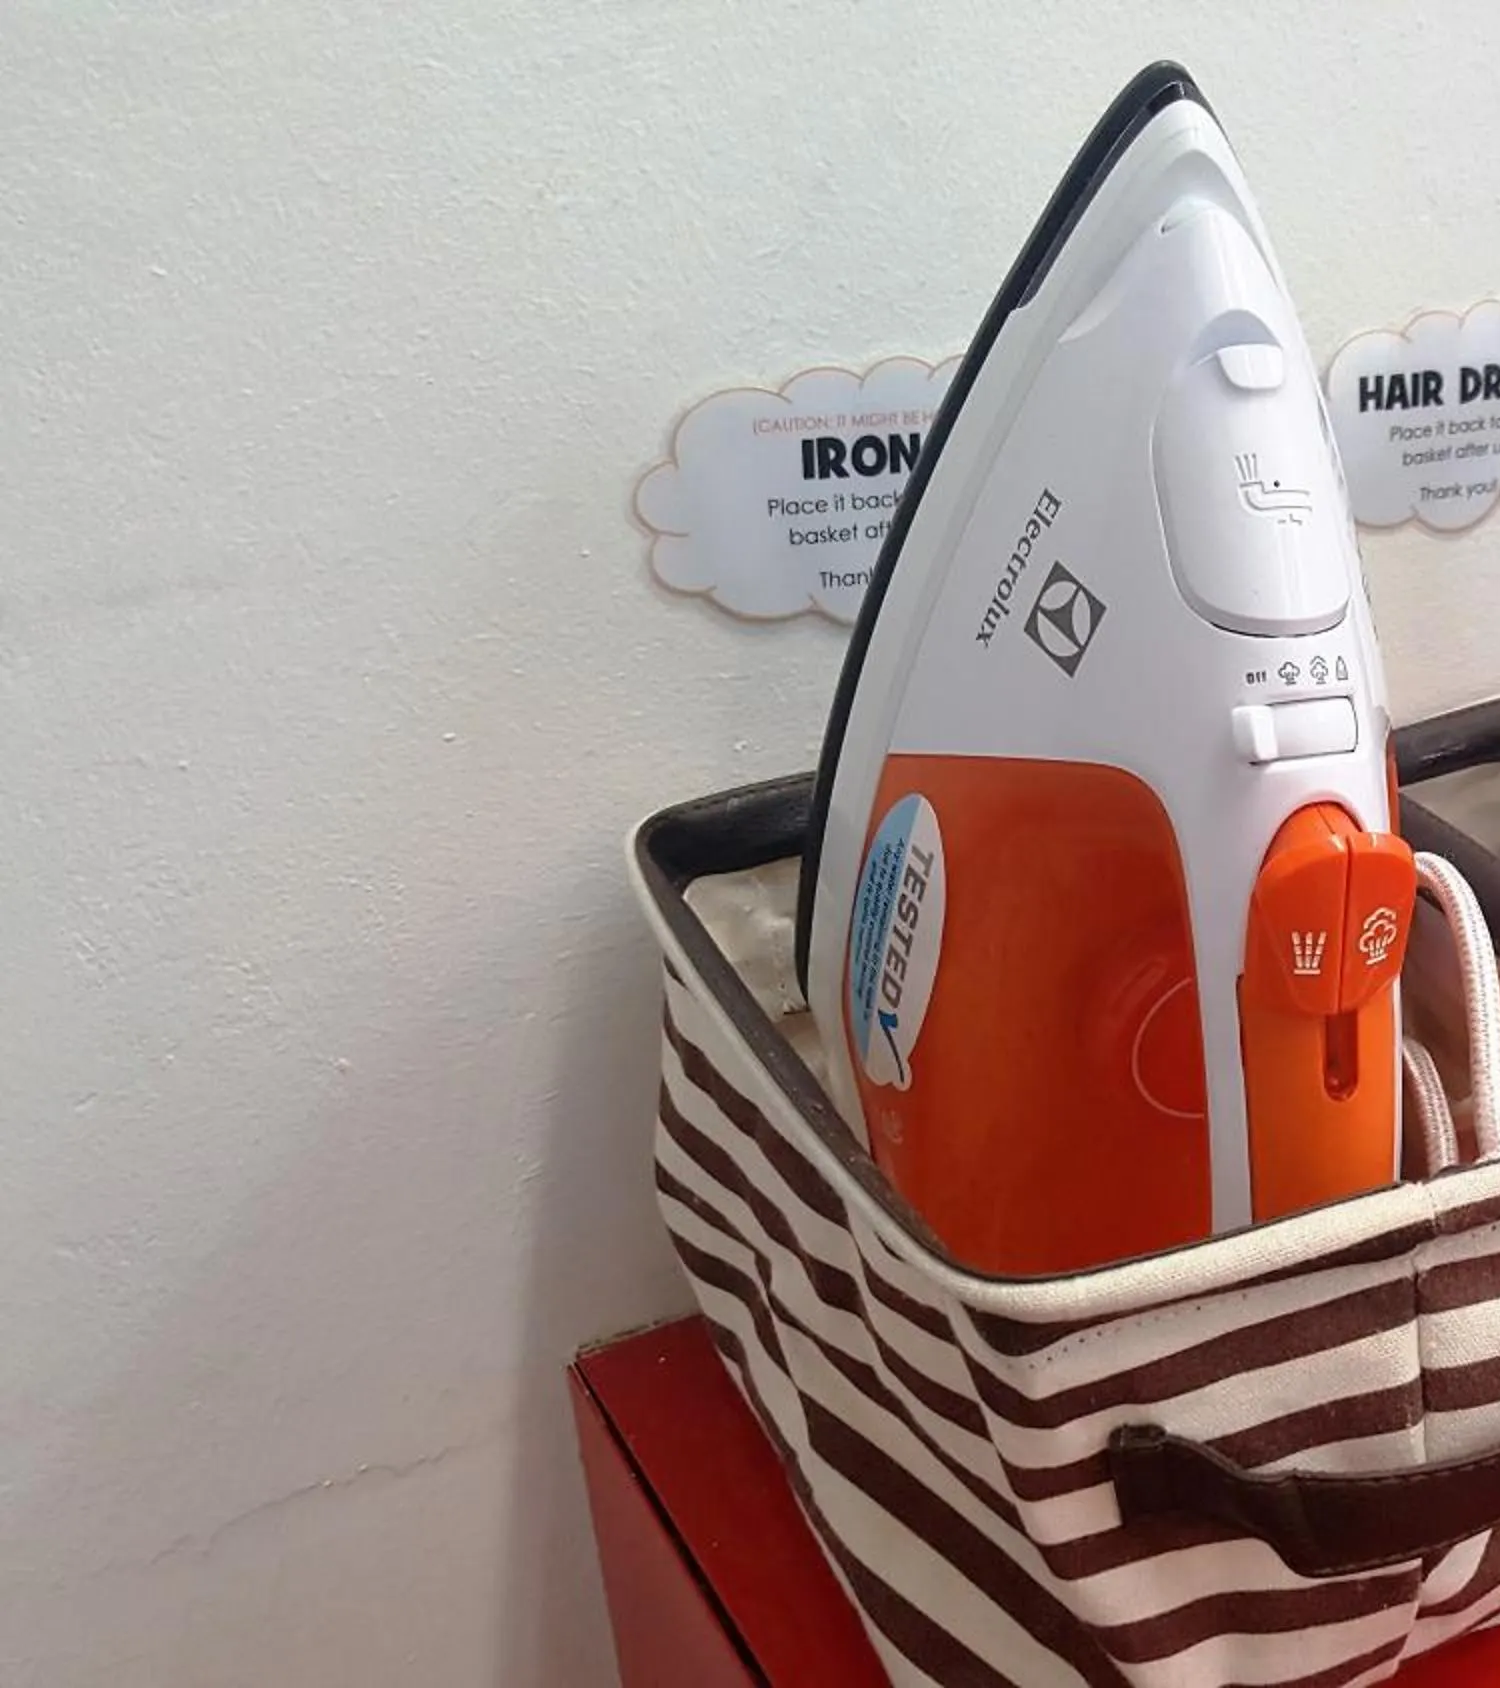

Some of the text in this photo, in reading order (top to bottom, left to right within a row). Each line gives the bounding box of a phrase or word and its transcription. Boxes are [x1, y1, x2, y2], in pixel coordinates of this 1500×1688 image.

[1358, 370, 1445, 413] HAIR
[851, 411, 899, 428] MIGHT
[903, 409, 921, 426] BE
[1389, 424, 1433, 442] Place
[1436, 420, 1446, 435] it
[1448, 417, 1486, 435] back
[800, 433, 921, 480] IRON
[1402, 446, 1453, 467] basket
[1455, 442, 1489, 459] after
[1419, 481, 1462, 501] Thank
[767, 494, 828, 518] Place
[834, 493, 847, 512] it
[789, 522, 858, 546] basket
[975, 487, 1062, 648] Electrolux
[881, 843, 934, 1010] TESTED
